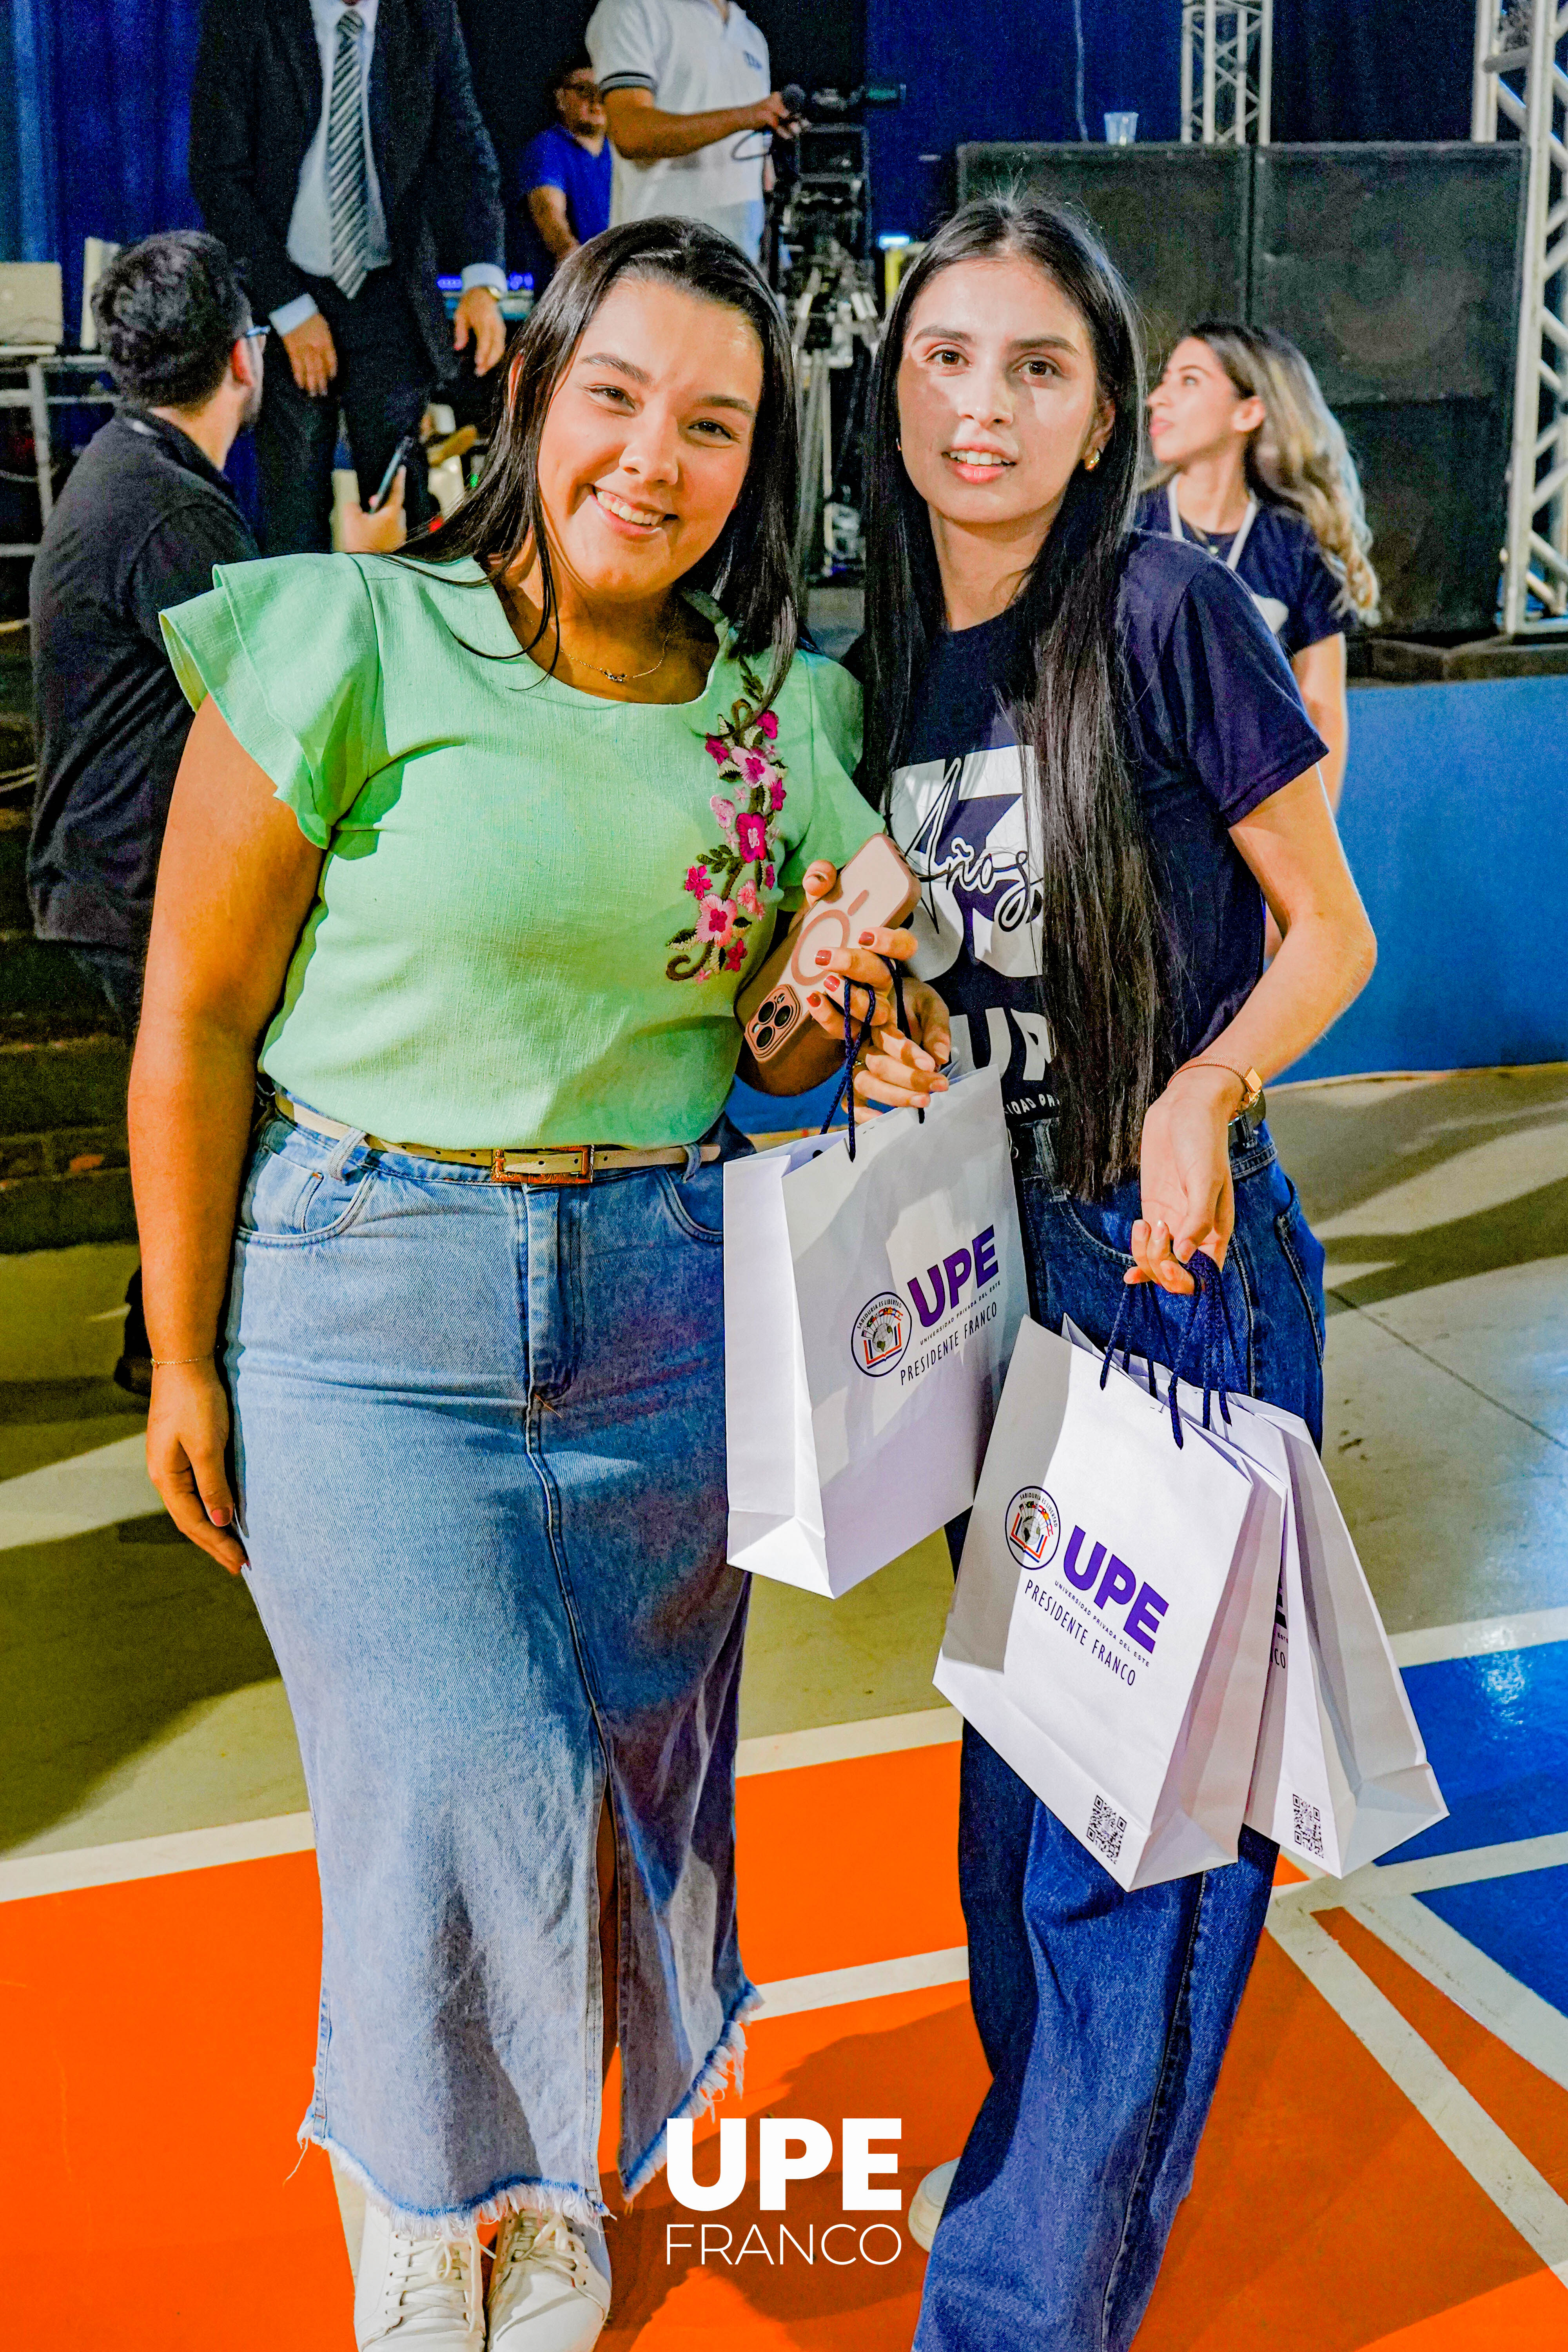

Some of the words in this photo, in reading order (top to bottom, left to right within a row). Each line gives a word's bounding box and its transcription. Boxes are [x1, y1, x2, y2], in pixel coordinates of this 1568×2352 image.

[857, 1304, 878, 1329] SABIDURIA
[884, 1299, 902, 1308] LIBERTAD
[907, 1224, 999, 1327] UPE
[920, 1317, 954, 1345] UNIVERSIDAD
[956, 1299, 977, 1319] PRIVADA
[978, 1292, 987, 1301] DEL
[989, 1280, 1001, 1293] ESTE
[900, 1331, 959, 1386] PRESIDENTE
[964, 1301, 997, 1339] FRANCO
[1046, 1503, 1057, 1527] LIBERTAD
[1054, 1580, 1091, 1615] UNIVERSIDAD
[1093, 1615, 1117, 1640] PRIVADA
[1119, 1639, 1131, 1652] DEL
[1133, 1651, 1150, 1667] ESTE
[1063, 1524, 1170, 1654] UPE
[1024, 1579, 1088, 1646] PRESIDENTE
[1092, 1639, 1136, 1686] FRANCO
